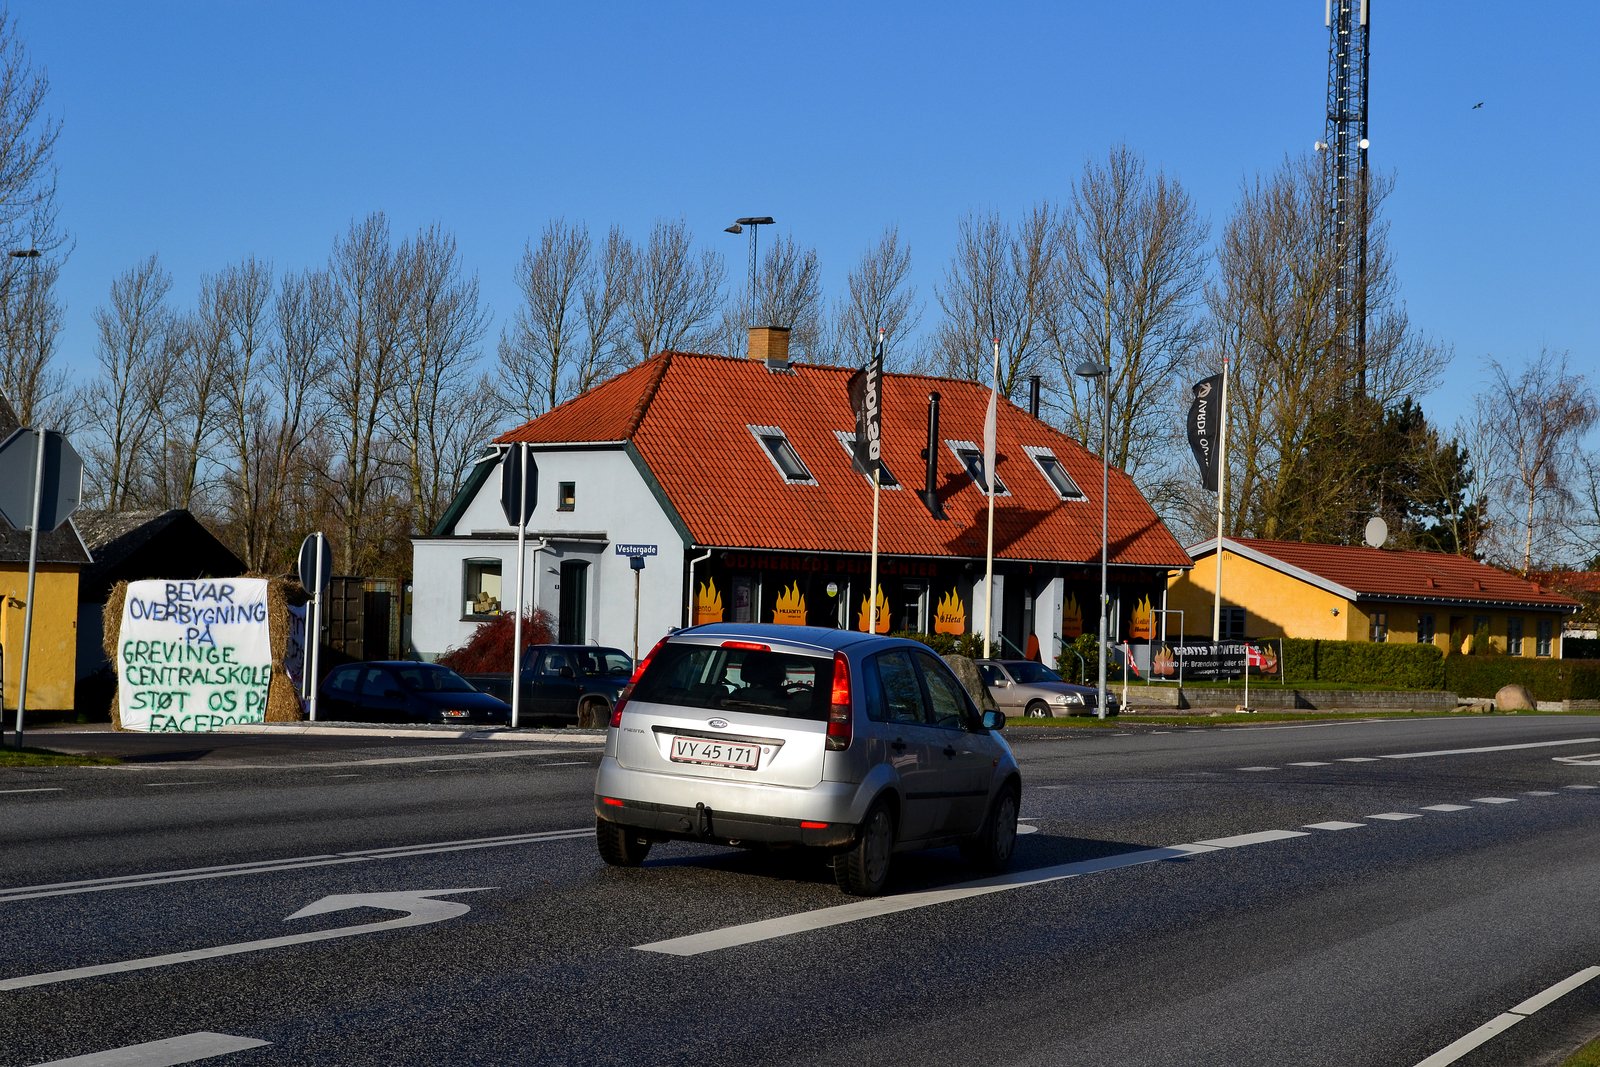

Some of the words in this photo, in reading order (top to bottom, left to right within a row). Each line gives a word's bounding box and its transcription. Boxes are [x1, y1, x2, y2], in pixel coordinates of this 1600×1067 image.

[617, 545, 657, 555] Vestergade
[165, 582, 235, 604] BEVAR
[130, 597, 266, 625] OVERBYGNING
[944, 614, 961, 623] Heta
[186, 624, 215, 645] PÅ
[123, 638, 239, 664] GREVINGE
[1173, 646, 1208, 656] GRATIS
[126, 662, 271, 687] CENTRALSKOLE
[129, 691, 190, 713] STØT
[208, 690, 237, 712] OS
[677, 741, 699, 757] VY
[702, 744, 721, 759] 45
[727, 747, 751, 763] 171
